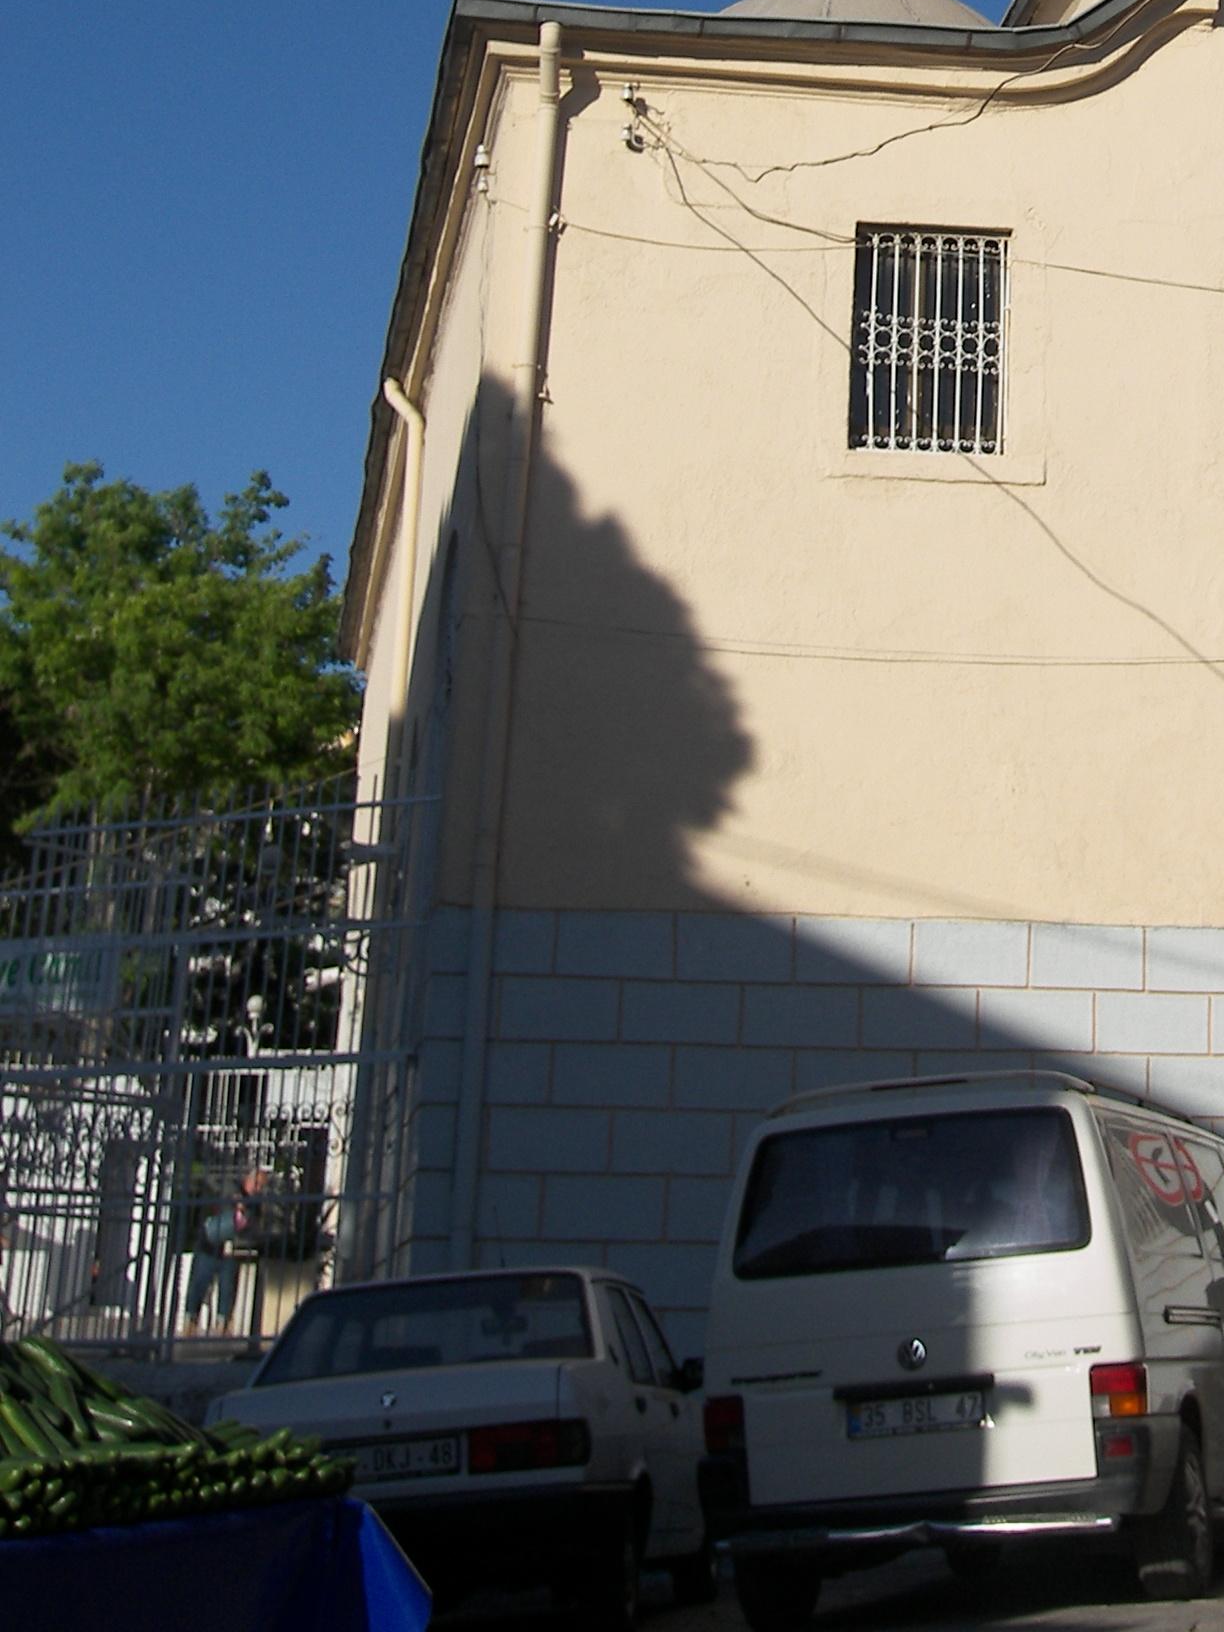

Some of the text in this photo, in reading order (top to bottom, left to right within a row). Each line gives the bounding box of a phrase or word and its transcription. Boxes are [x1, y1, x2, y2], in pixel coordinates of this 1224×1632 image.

[863, 1394, 979, 1427] 35 BSL 47
